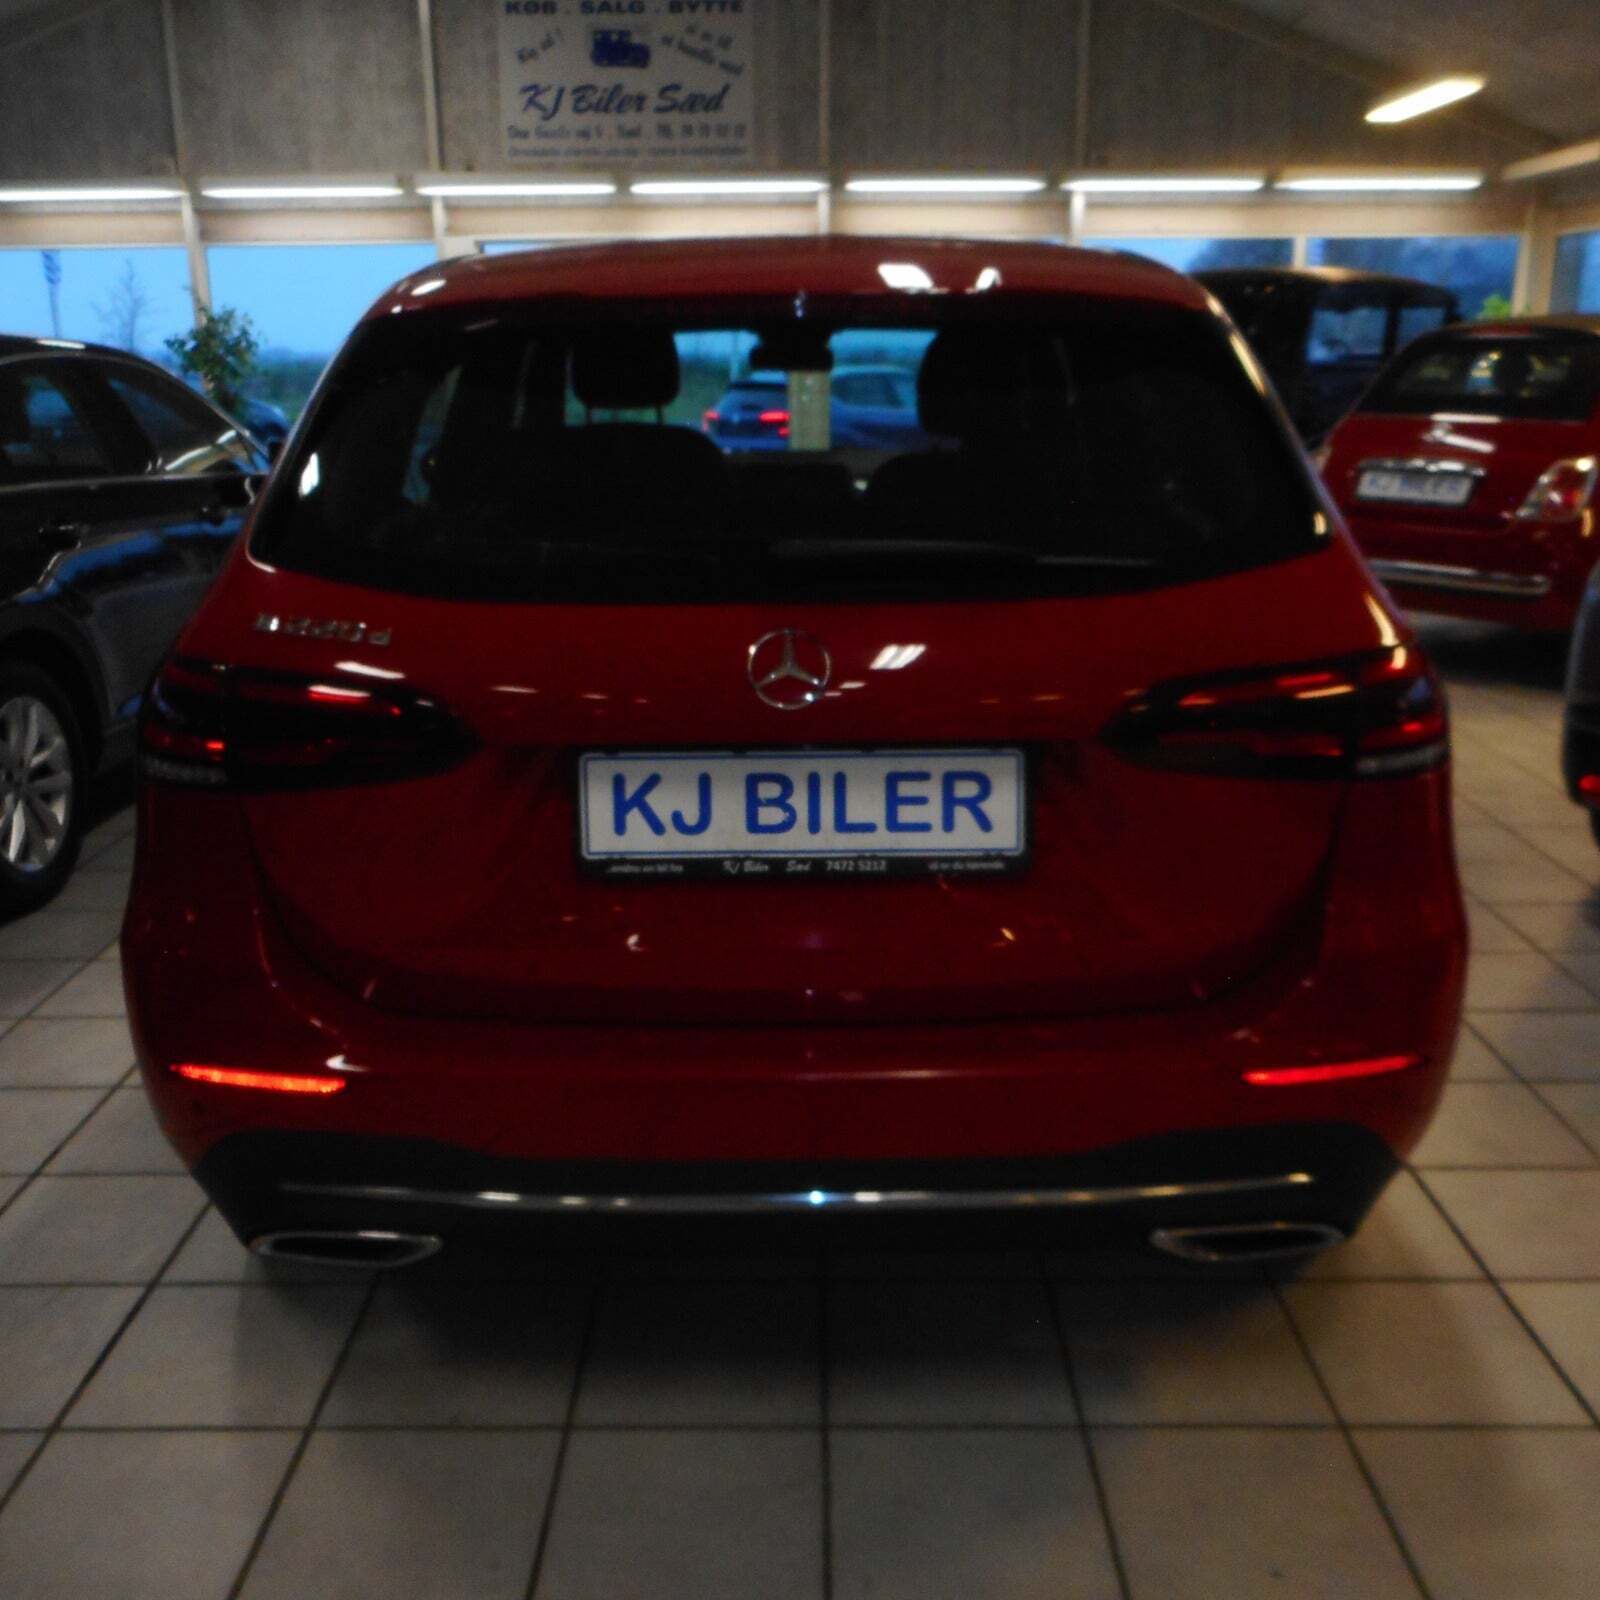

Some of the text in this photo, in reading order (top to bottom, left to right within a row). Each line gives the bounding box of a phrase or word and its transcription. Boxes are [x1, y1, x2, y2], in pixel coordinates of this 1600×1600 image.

[580, 0, 646, 14] SALG
[668, 0, 744, 14] BYTTE
[519, 83, 565, 121] KJ
[570, 82, 648, 114] Biler
[612, 770, 994, 836] KJ BILER
